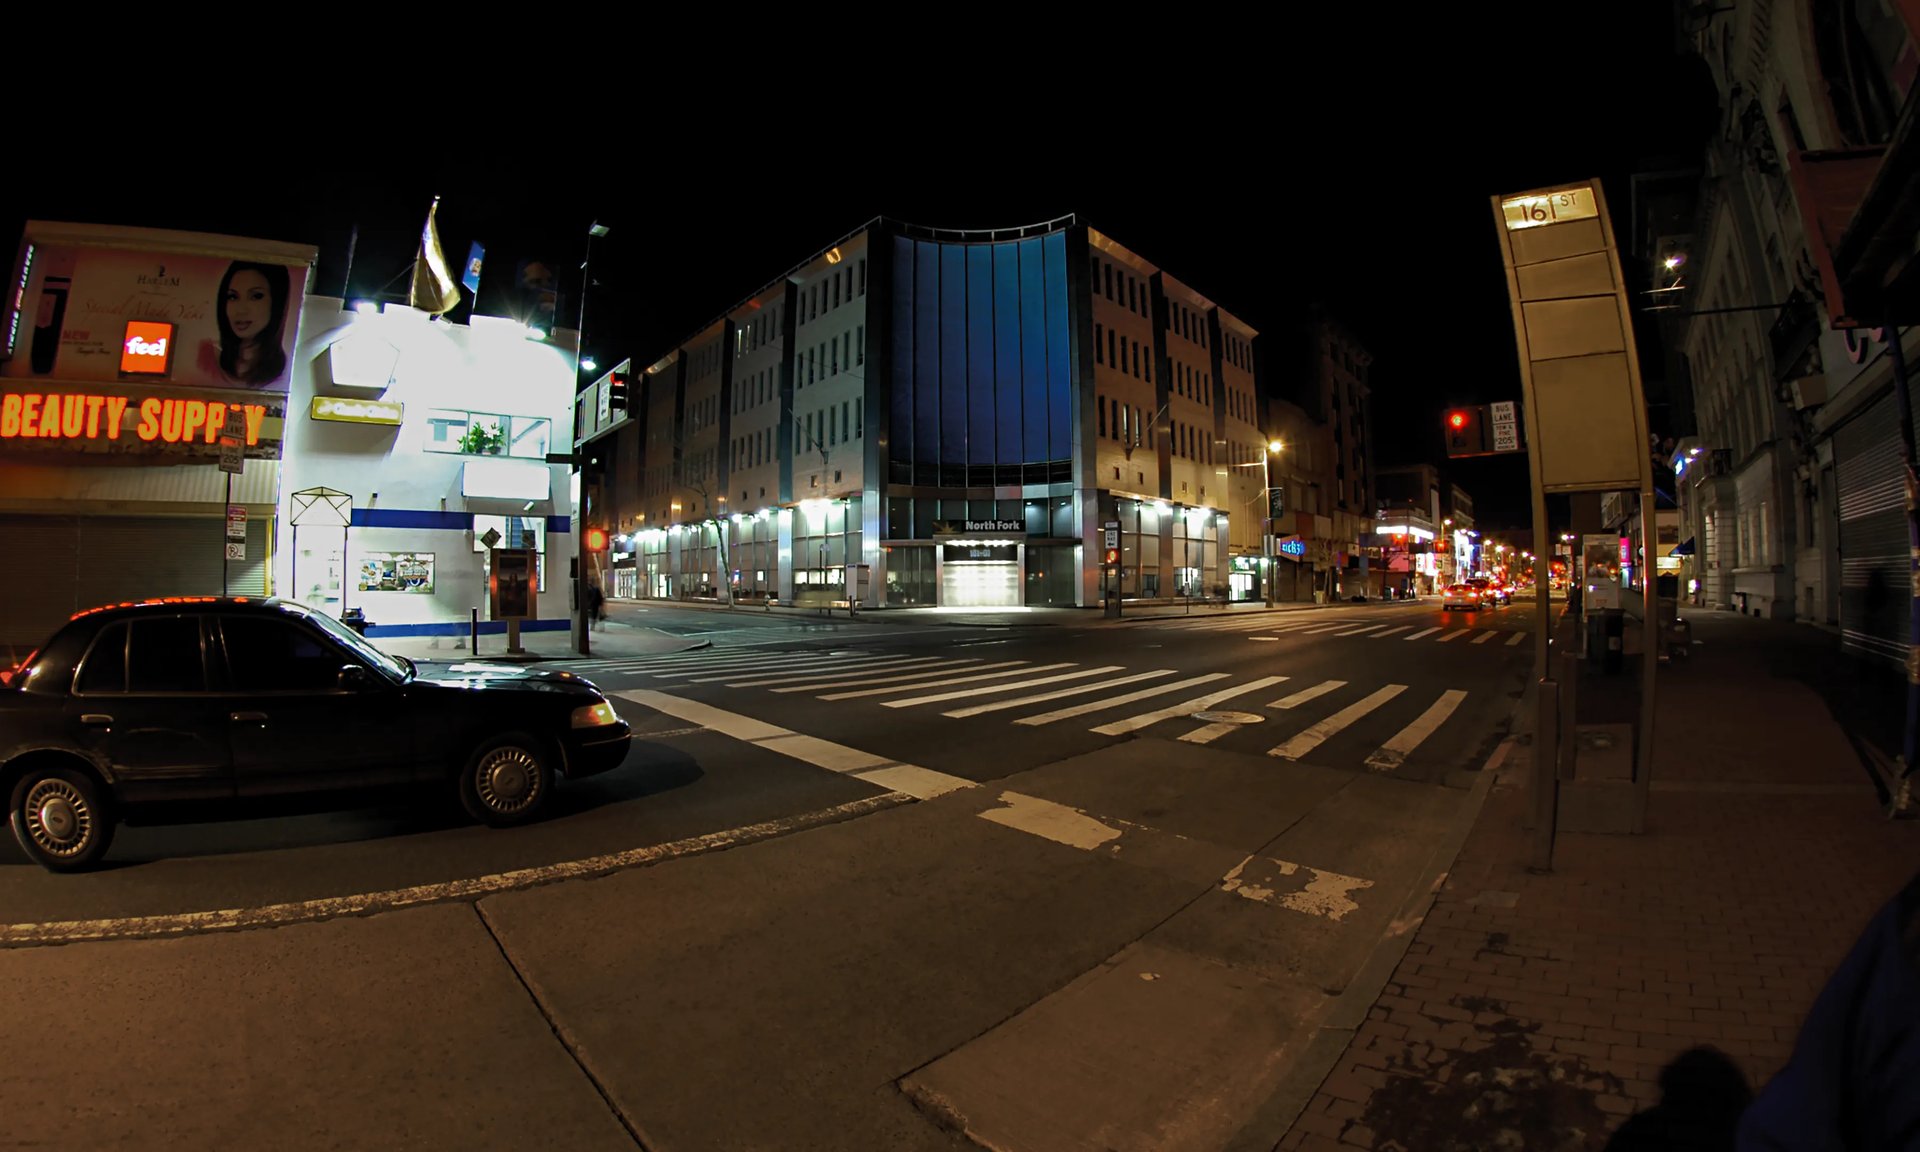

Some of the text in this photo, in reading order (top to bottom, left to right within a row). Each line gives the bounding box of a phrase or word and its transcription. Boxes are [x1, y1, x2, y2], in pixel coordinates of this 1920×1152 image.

[1519, 192, 1576, 222] 161 ST
[1495, 404, 1509, 412] BUS
[1, 394, 127, 440] BEAUTY
[228, 412, 243, 424] BUS
[1494, 413, 1512, 422] LANE
[225, 424, 244, 436] LANE
[965, 521, 1020, 530] North Fork
